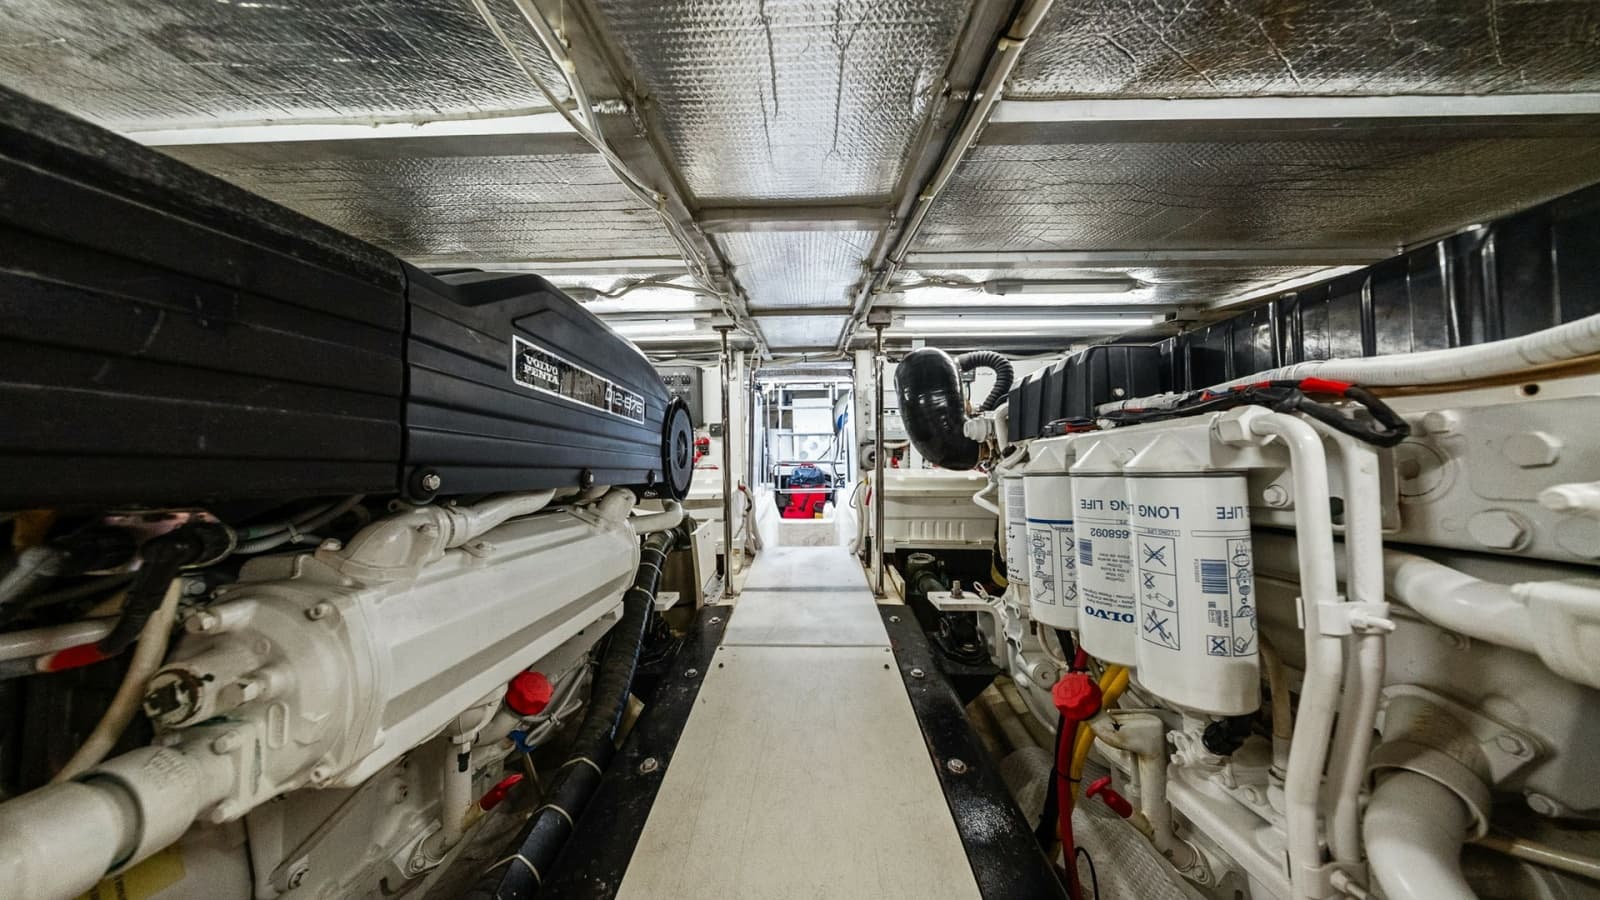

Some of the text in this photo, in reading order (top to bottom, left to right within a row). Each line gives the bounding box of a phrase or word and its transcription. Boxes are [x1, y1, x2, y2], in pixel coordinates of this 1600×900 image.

[523, 353, 558, 376] VOLVO
[523, 363, 559, 385] PENTA
[1080, 499, 1104, 510] LIFE
[1110, 500, 1128, 511] NG
[1138, 505, 1244, 520] LIFE LONG
[1085, 605, 1135, 623] OLVO
